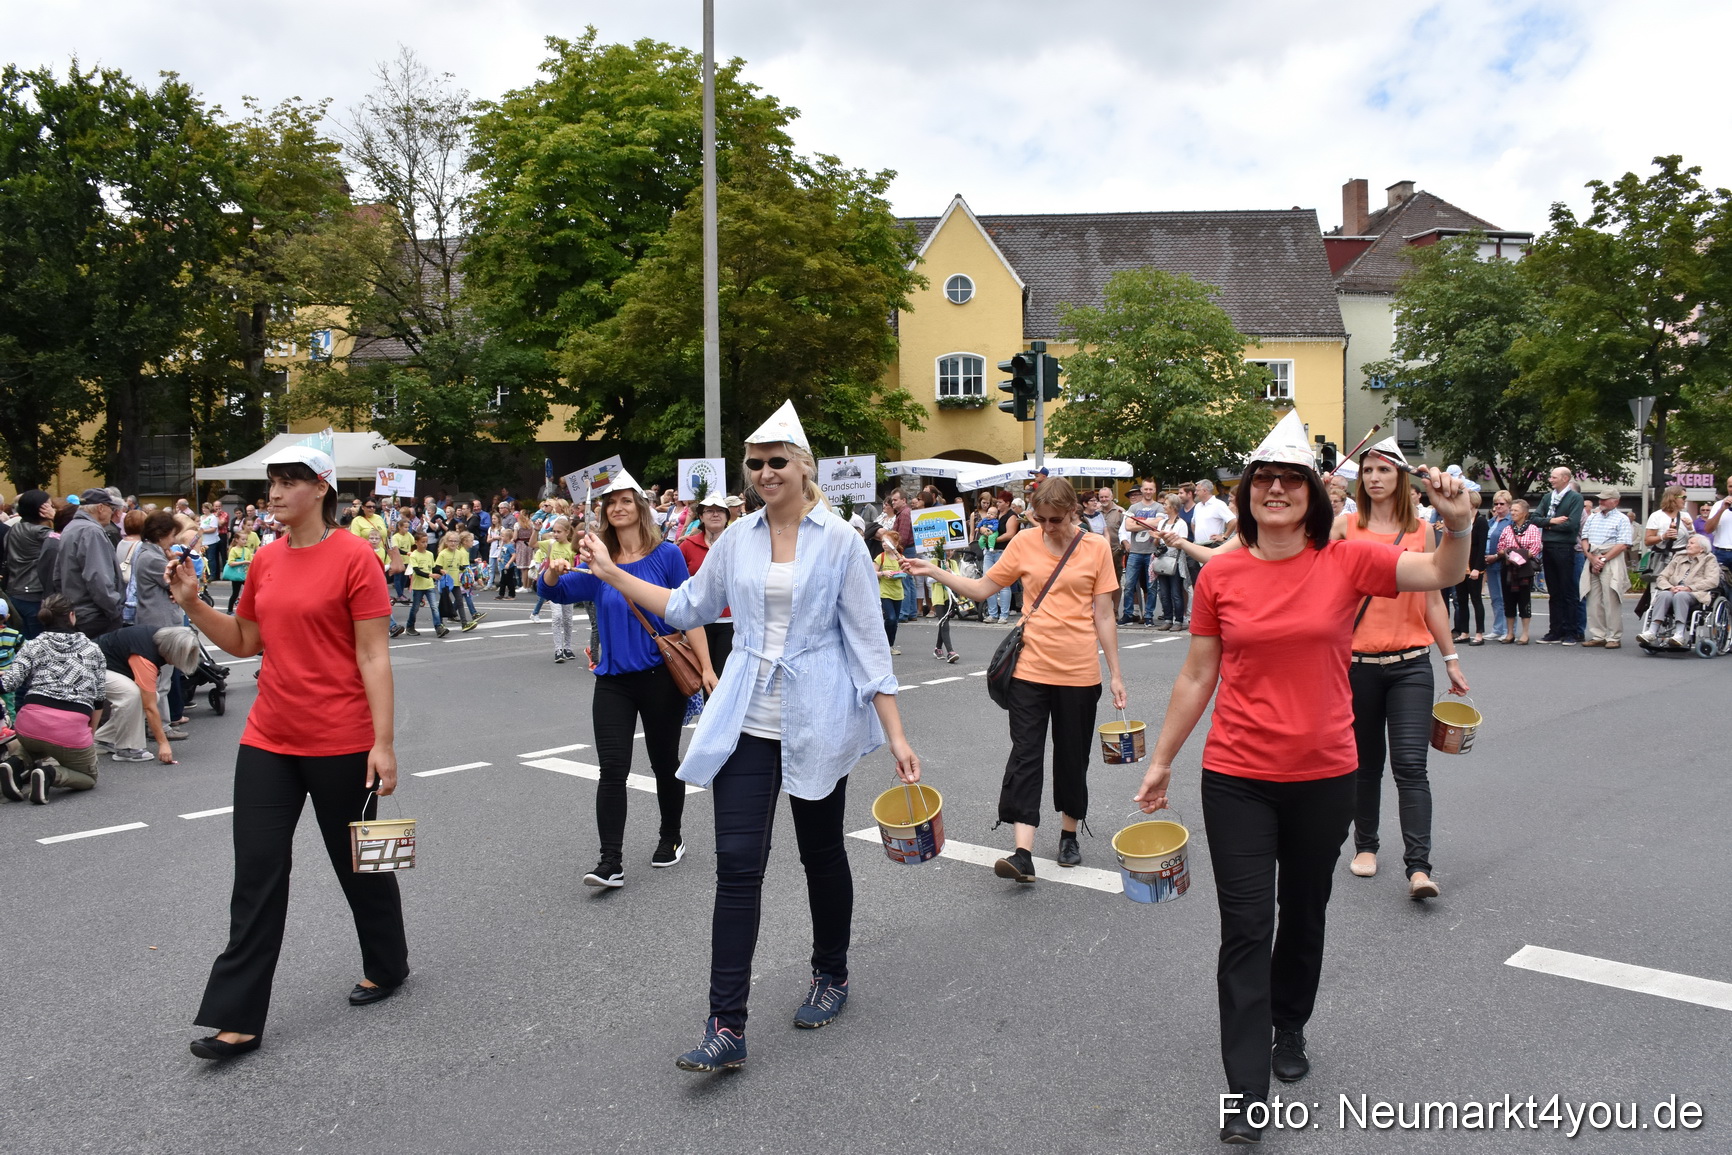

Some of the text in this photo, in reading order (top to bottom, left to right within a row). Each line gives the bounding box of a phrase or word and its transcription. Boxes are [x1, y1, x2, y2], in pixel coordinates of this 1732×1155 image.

[821, 480, 871, 492] Grundschule
[829, 493, 866, 503] Holeim
[914, 530, 947, 539] Fairtrade
